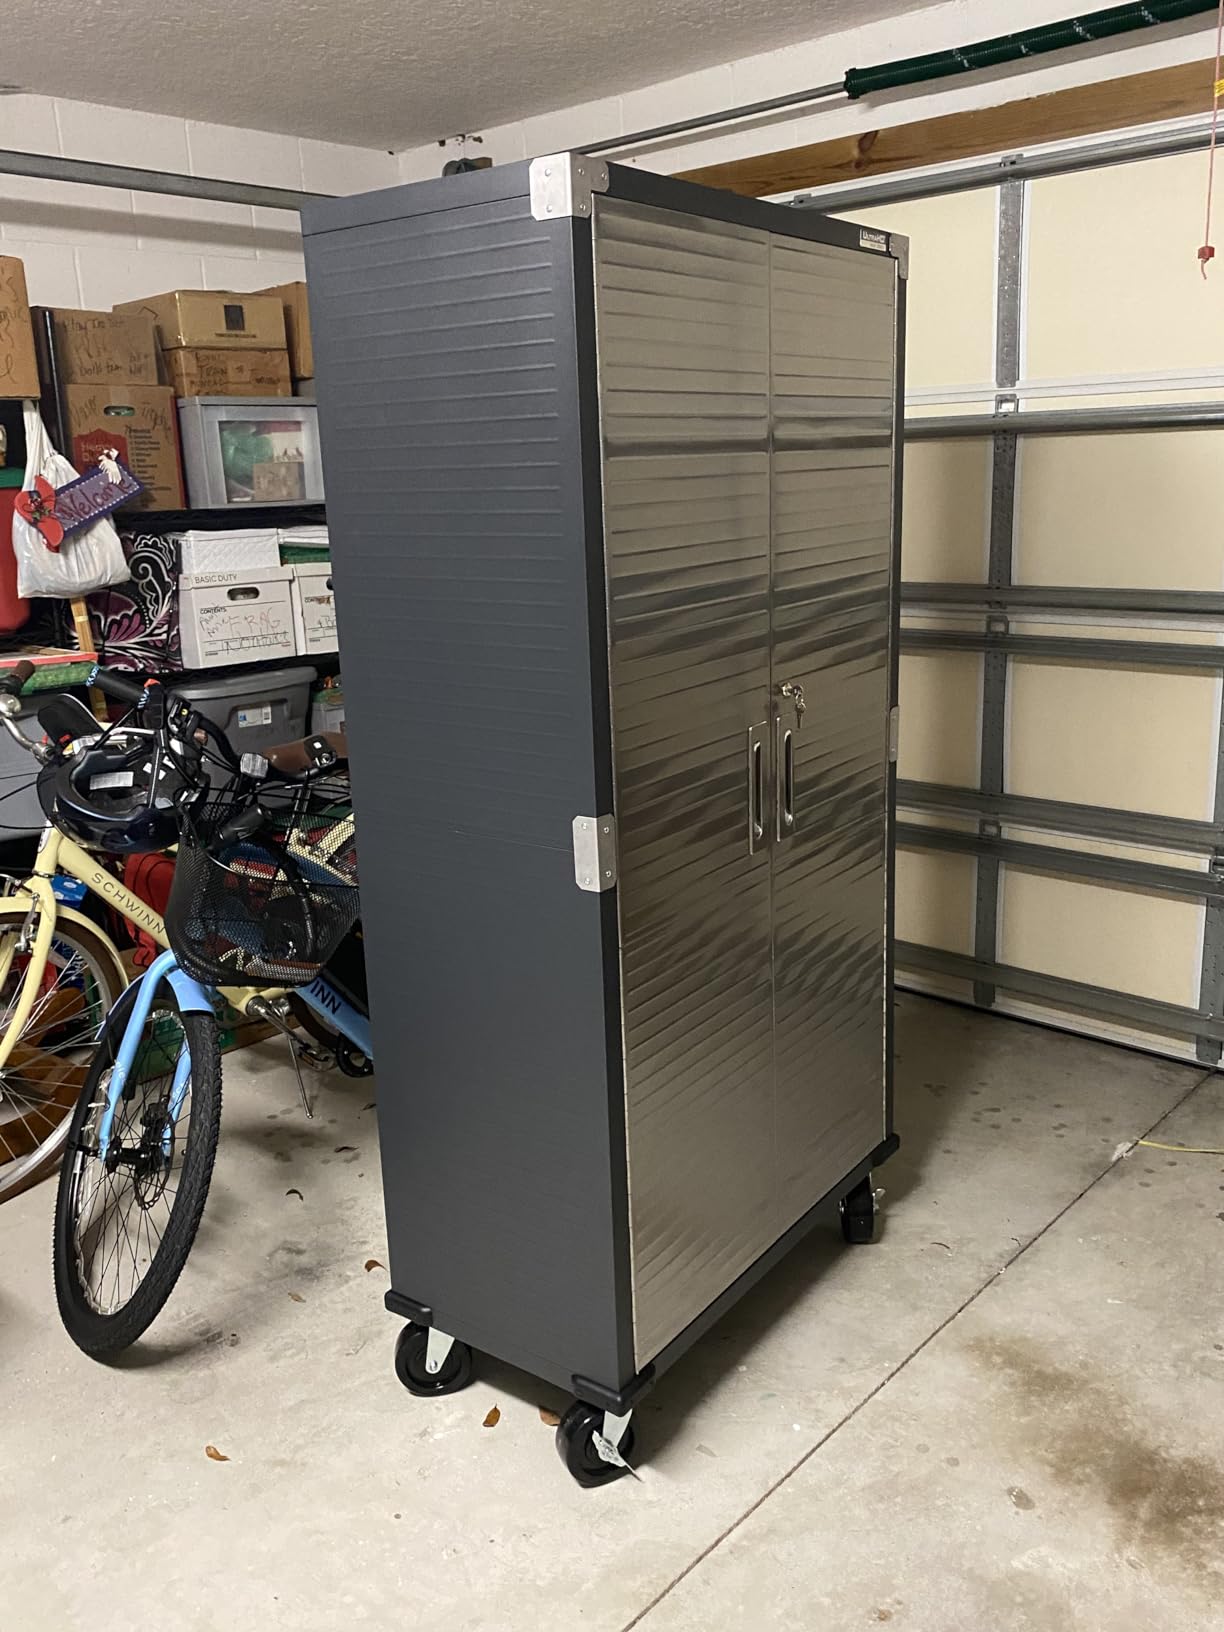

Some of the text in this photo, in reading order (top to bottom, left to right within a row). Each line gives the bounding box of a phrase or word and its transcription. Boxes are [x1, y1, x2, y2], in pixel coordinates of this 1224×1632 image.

[58, 479, 132, 520] Welcome
[194, 573, 237, 584] BASIC DUTY
[199, 605, 227, 615] CONTENTS
[92, 872, 165, 934] SCHWINN
